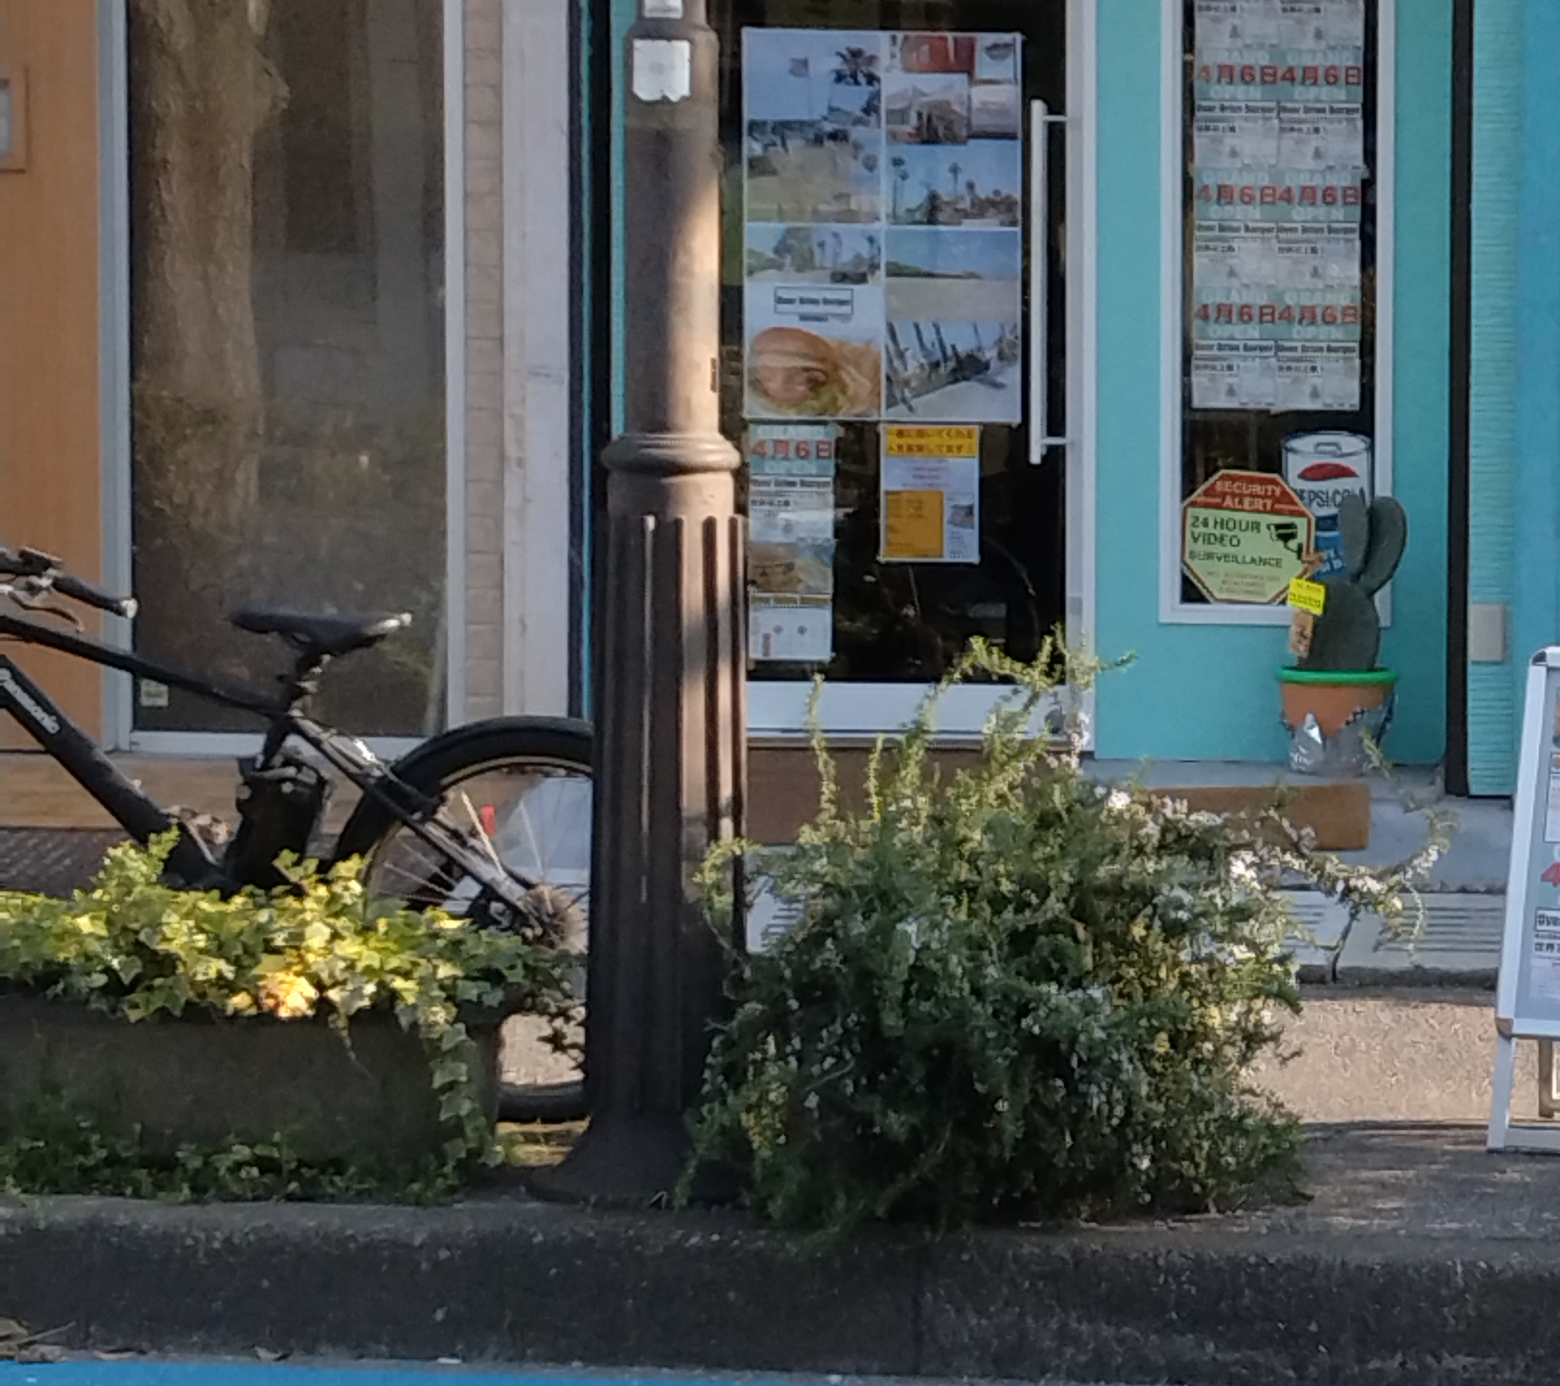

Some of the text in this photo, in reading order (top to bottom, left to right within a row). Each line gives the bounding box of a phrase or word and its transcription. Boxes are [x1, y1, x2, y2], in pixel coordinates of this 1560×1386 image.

[1215, 480, 1281, 497] SECURITY
[1222, 495, 1274, 511] ALERT
[1190, 515, 1262, 534] 24 HOUR
[1190, 531, 1241, 548] VIDEO
[1188, 550, 1283, 568] SURVEILLANCE
